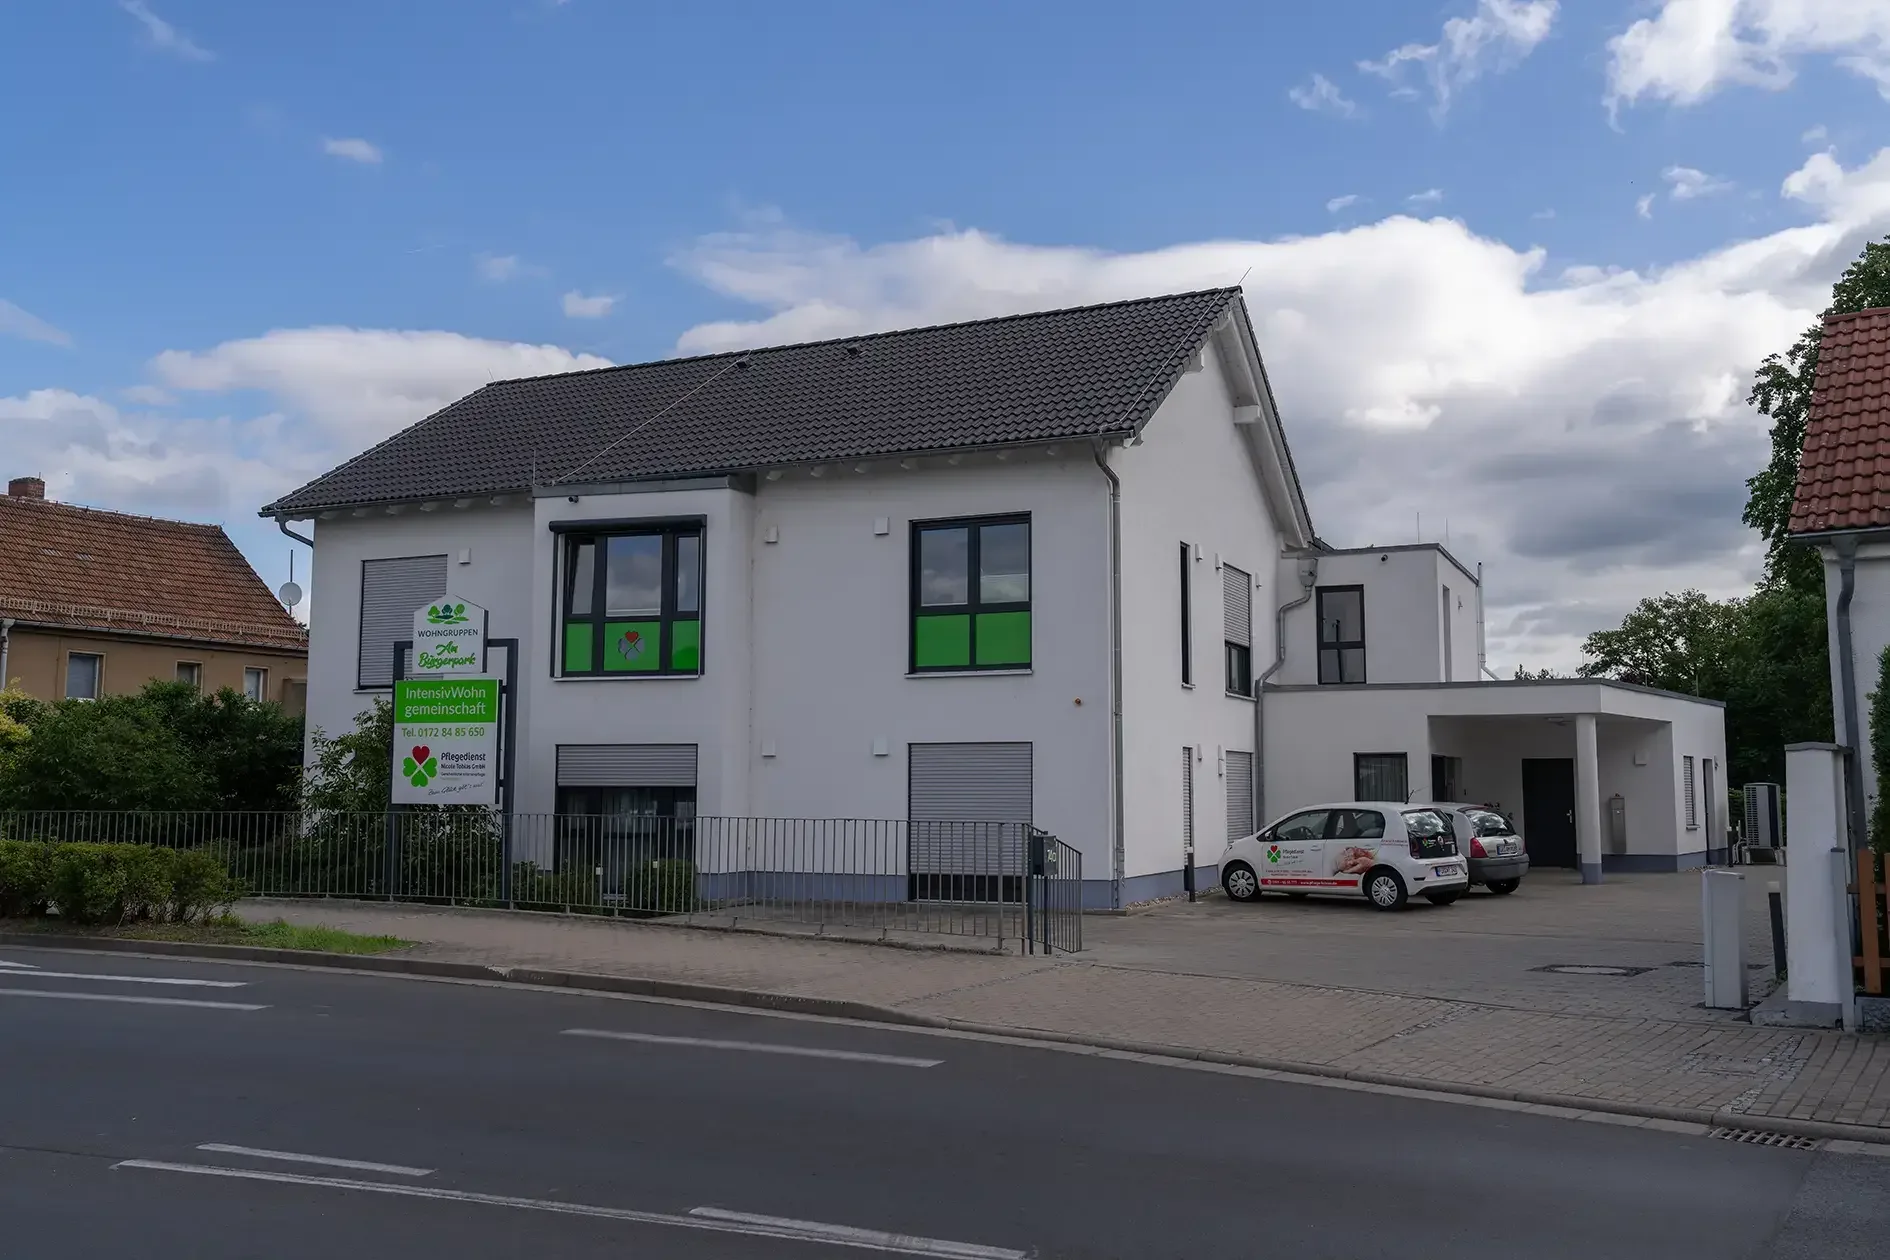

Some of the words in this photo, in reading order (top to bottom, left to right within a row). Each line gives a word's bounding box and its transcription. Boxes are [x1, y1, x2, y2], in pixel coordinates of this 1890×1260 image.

[418, 629, 478, 638] WOHNGRUPPEN
[436, 641, 458, 655] Am
[418, 652, 476, 669] Bürgerpark
[406, 686, 486, 699] IntensivWohn
[404, 702, 486, 718] gemeinschaft
[401, 728, 416, 737] Tel.
[418, 728, 439, 737] 0172
[441, 728, 452, 737] 84
[454, 727, 466, 737] 85
[468, 727, 485, 737] 650
[441, 752, 486, 762] Pflegedienst
